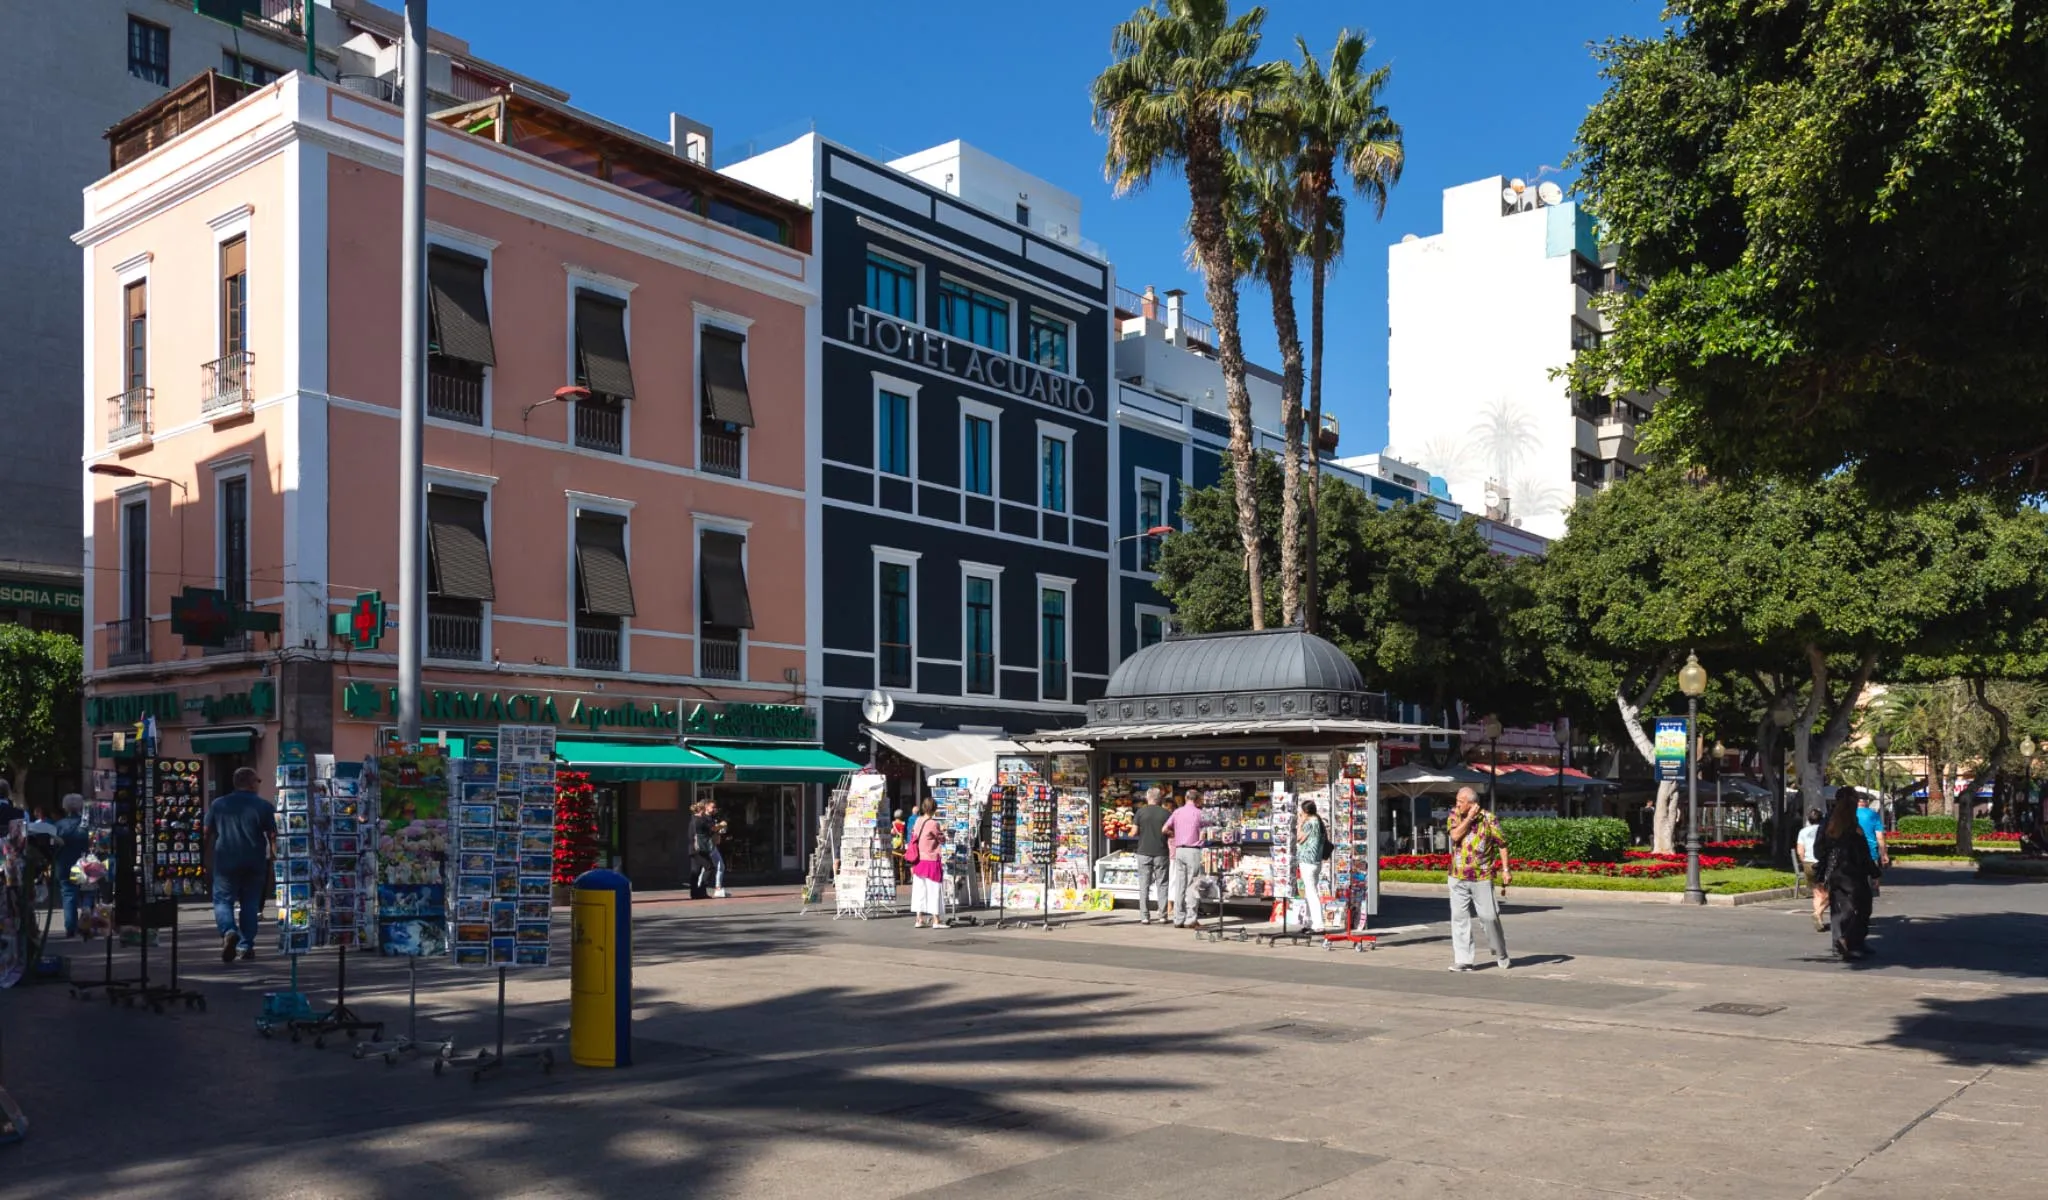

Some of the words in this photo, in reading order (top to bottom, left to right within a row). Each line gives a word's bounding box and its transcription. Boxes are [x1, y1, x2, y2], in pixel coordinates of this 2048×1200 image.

[847, 307, 956, 373] HOTEL
[964, 349, 1094, 415] ACUARIO
[54, 592, 84, 608] FIG
